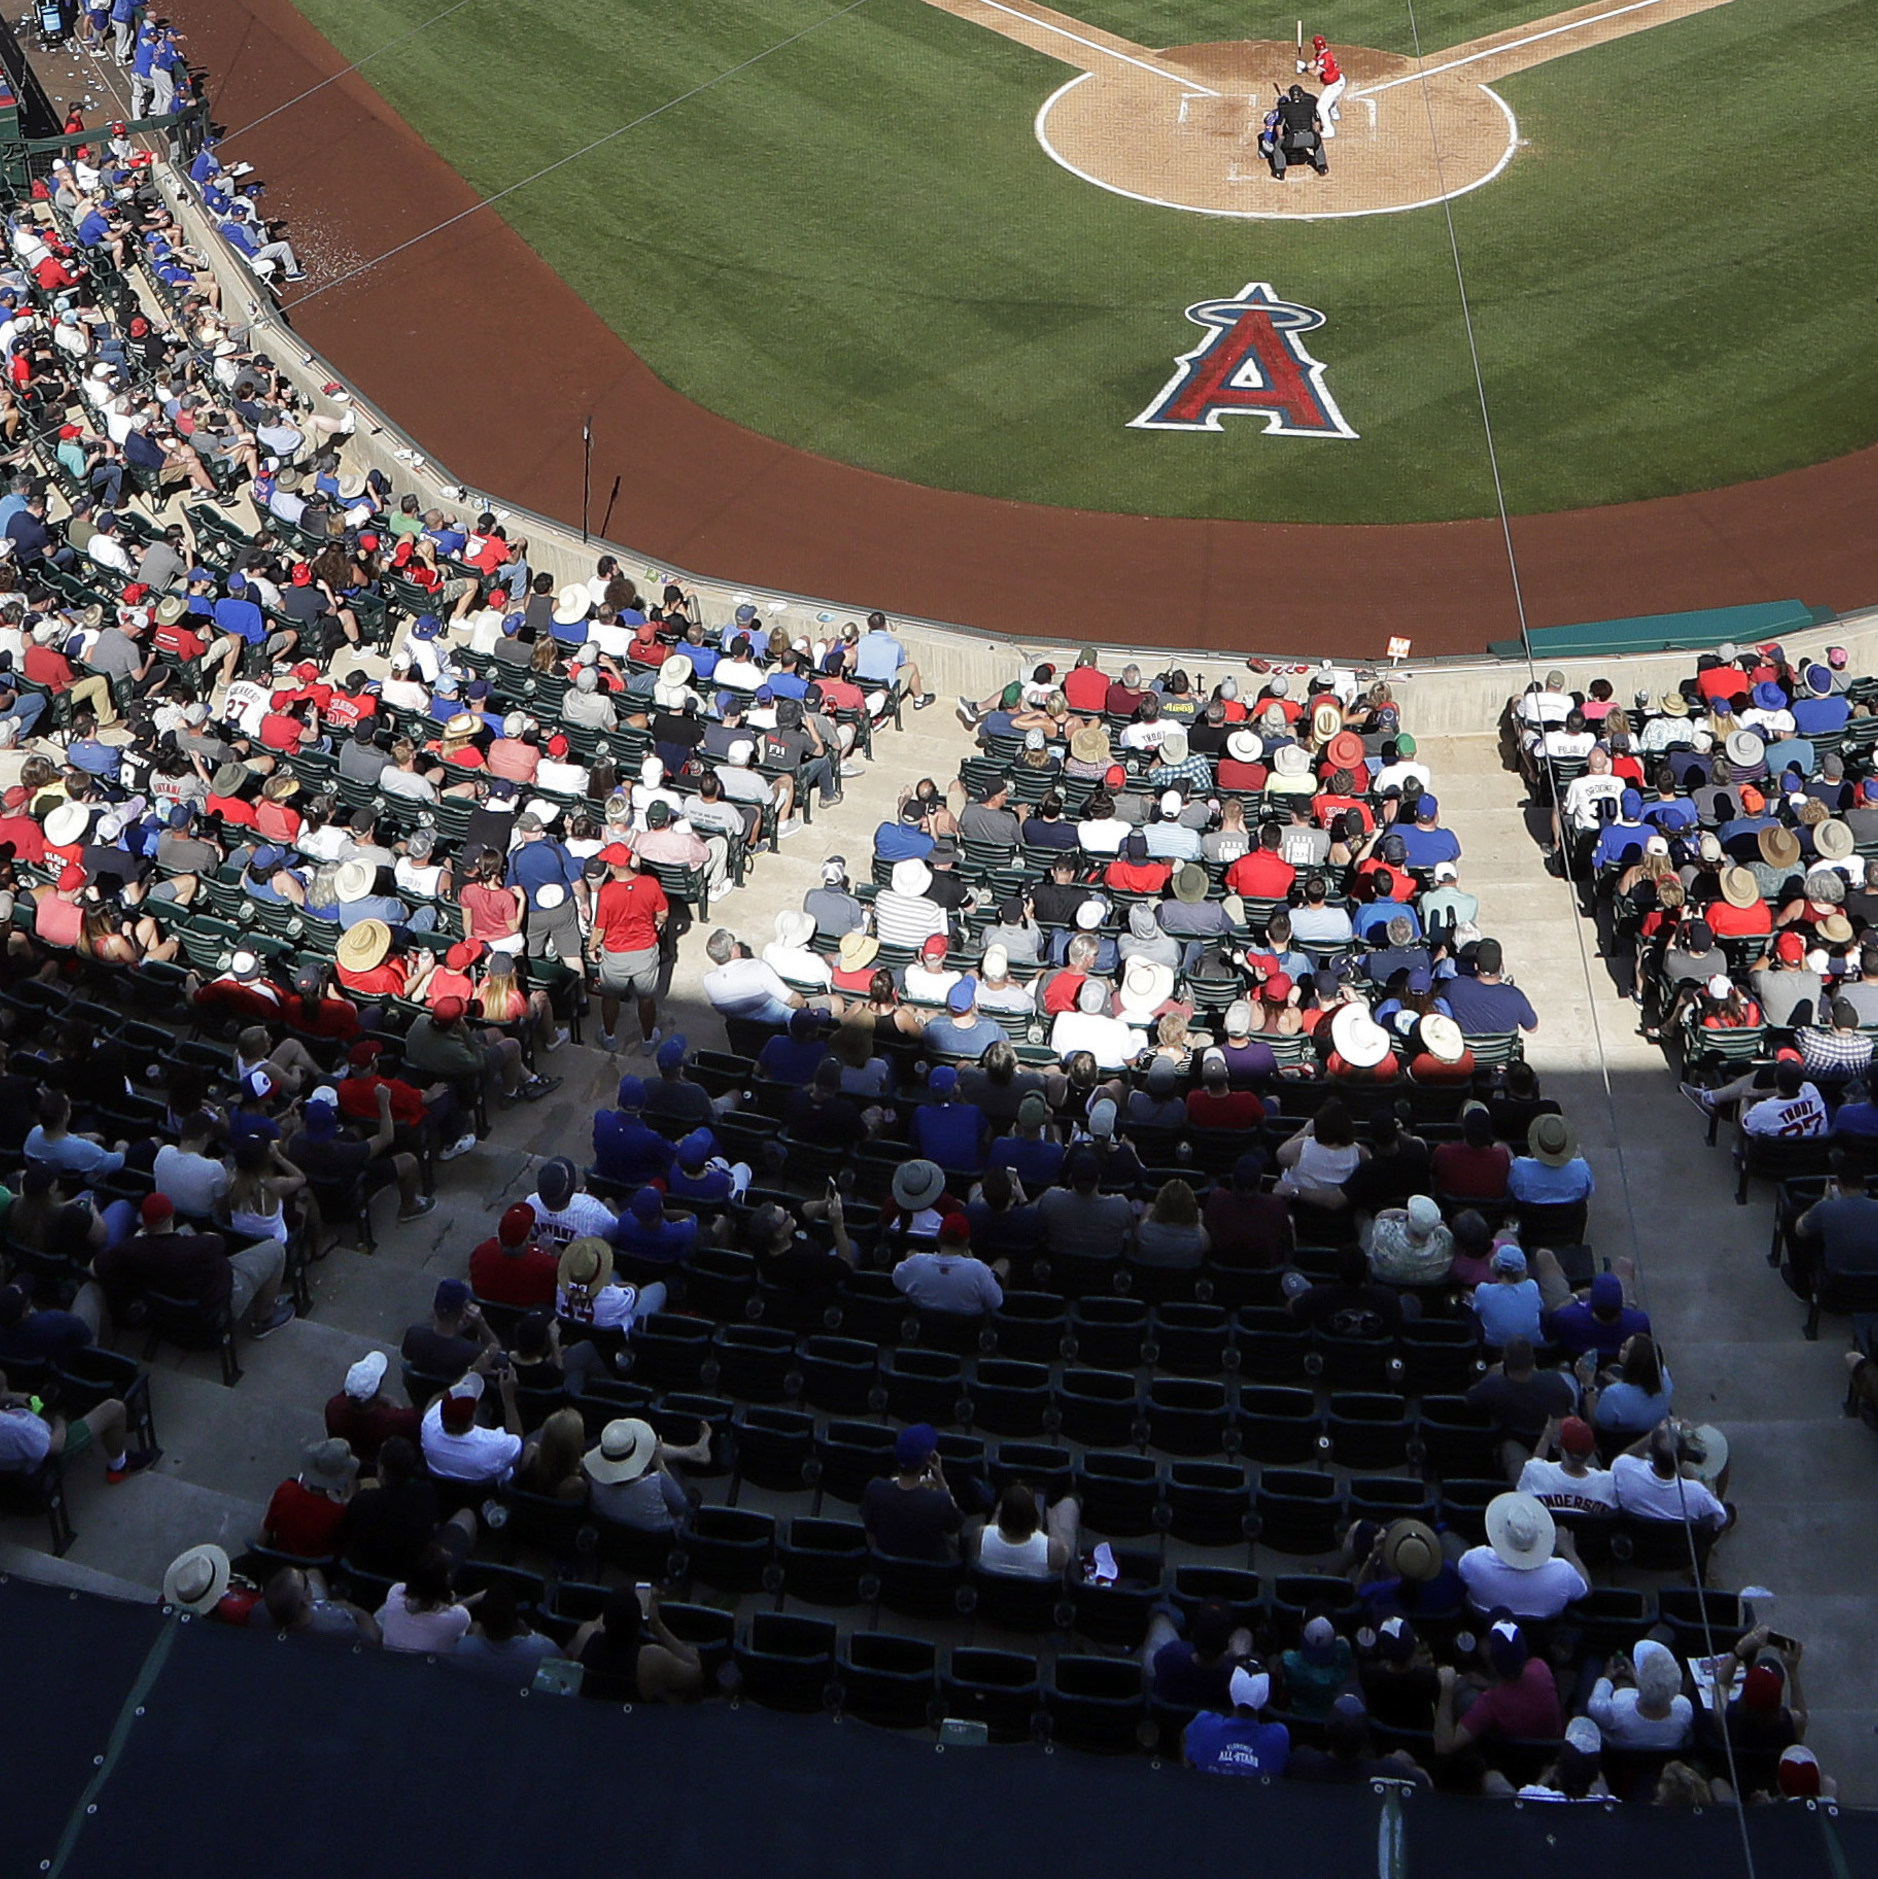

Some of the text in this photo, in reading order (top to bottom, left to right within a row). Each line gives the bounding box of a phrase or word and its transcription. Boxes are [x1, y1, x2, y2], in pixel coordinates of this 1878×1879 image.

[1124, 282, 1360, 439] A
[225, 699, 249, 720] 27
[1589, 797, 1618, 821] 30
[1781, 1100, 1814, 1123] TROUT
